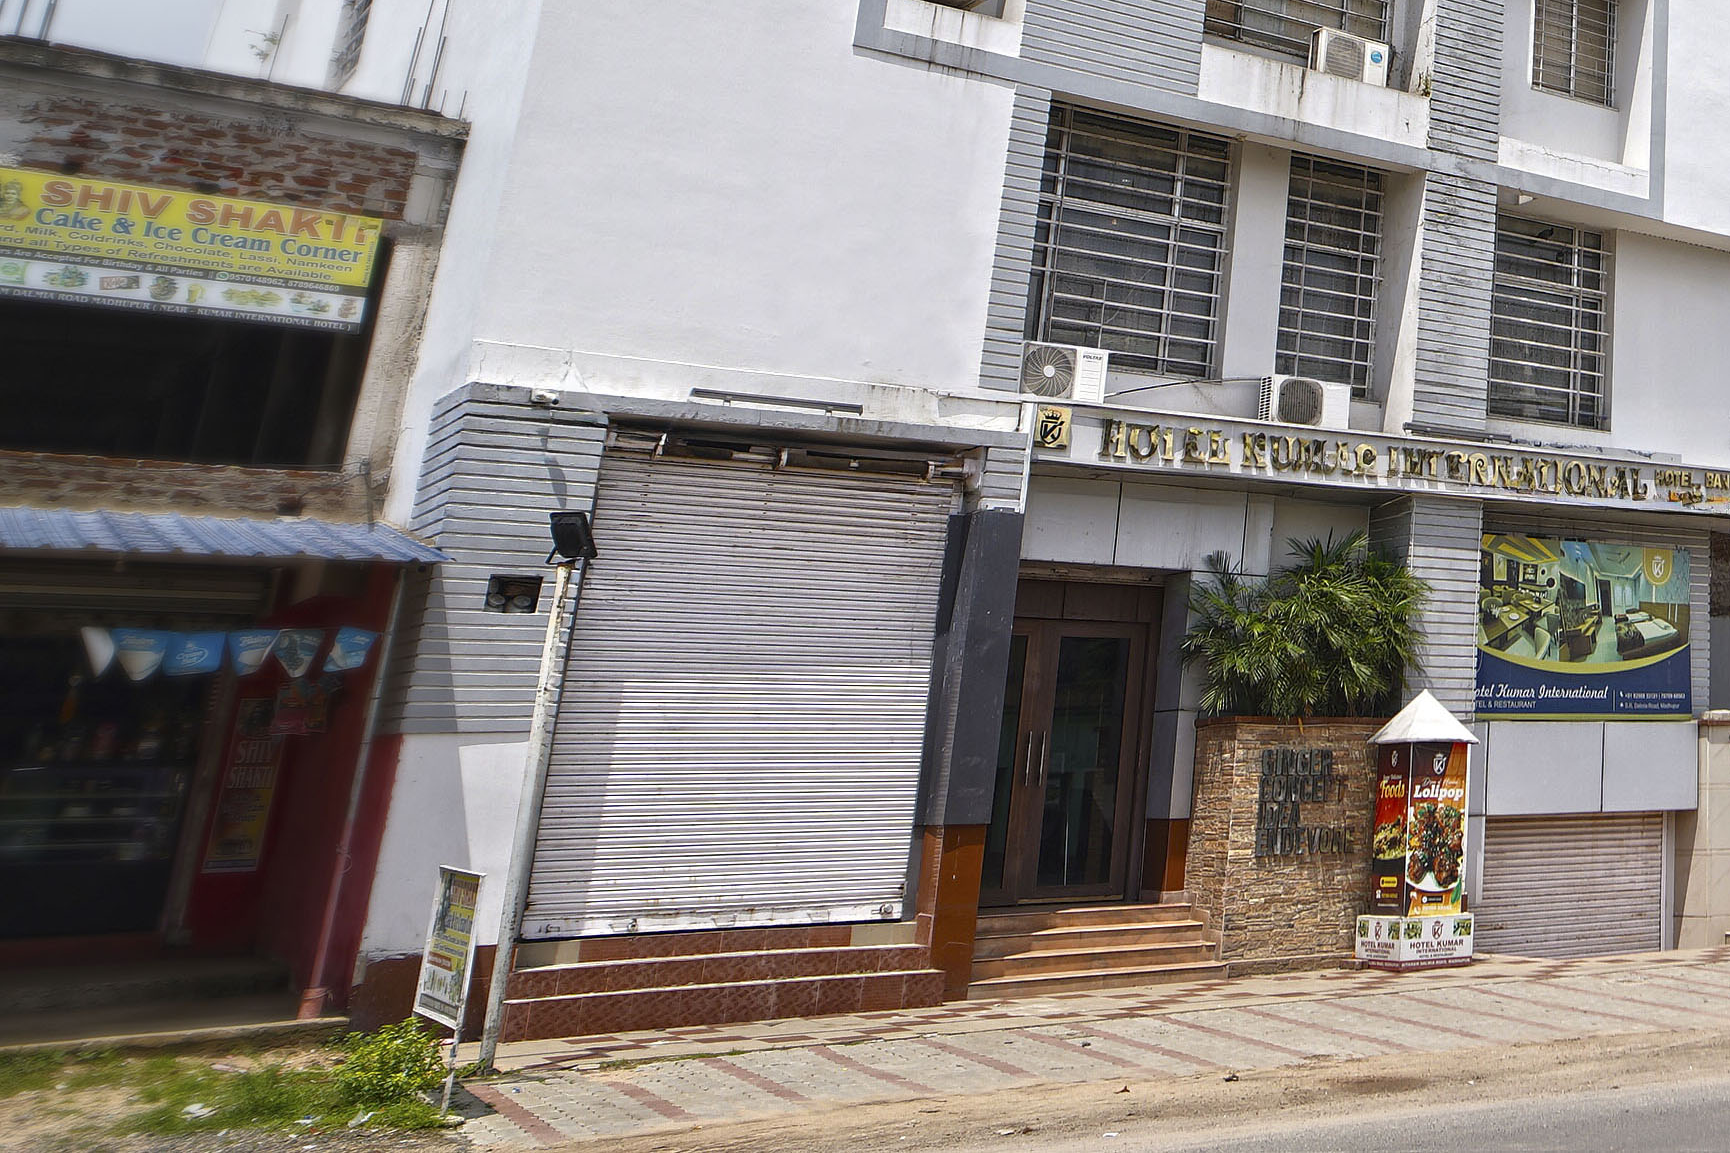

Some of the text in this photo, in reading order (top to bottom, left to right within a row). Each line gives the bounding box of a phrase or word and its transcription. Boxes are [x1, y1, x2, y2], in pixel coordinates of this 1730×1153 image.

[40, 180, 367, 245] SHIV SHAKTI
[36, 208, 103, 231] Cake
[112, 217, 135, 234] &
[143, 220, 183, 241] Ice
[192, 227, 270, 252] Cream
[280, 238, 363, 262] Corner
[54, 240, 101, 254] Types
[128, 249, 234, 269] Refreshments
[238, 264, 262, 273] are
[287, 258, 352, 272] Namkeen
[84, 257, 100, 265] For
[103, 259, 143, 271] Birthday
[170, 267, 204, 277] Parties
[57, 293, 89, 304] ROAD
[92, 297, 150, 311] MADHUPUR
[235, 312, 313, 326] INTERNATIONAL
[314, 321, 345, 330] HOTEL
[1387, 445, 1648, 501] INTERNATIONAL
[1654, 469, 1693, 487] HOTEL
[1474, 683, 1609, 699] otel Kumar International
[1494, 700, 1537, 709] RESTAURANT
[1261, 748, 1333, 776] GINGER
[1259, 774, 1348, 802] CONCEPT
[1380, 779, 1405, 799] Foods
[1413, 784, 1465, 802] Lolipop
[1256, 801, 1301, 829] IDEA
[1361, 940, 1395, 950] HOTEL KUMAR
[1409, 938, 1464, 950] HOTEL KUMAR
